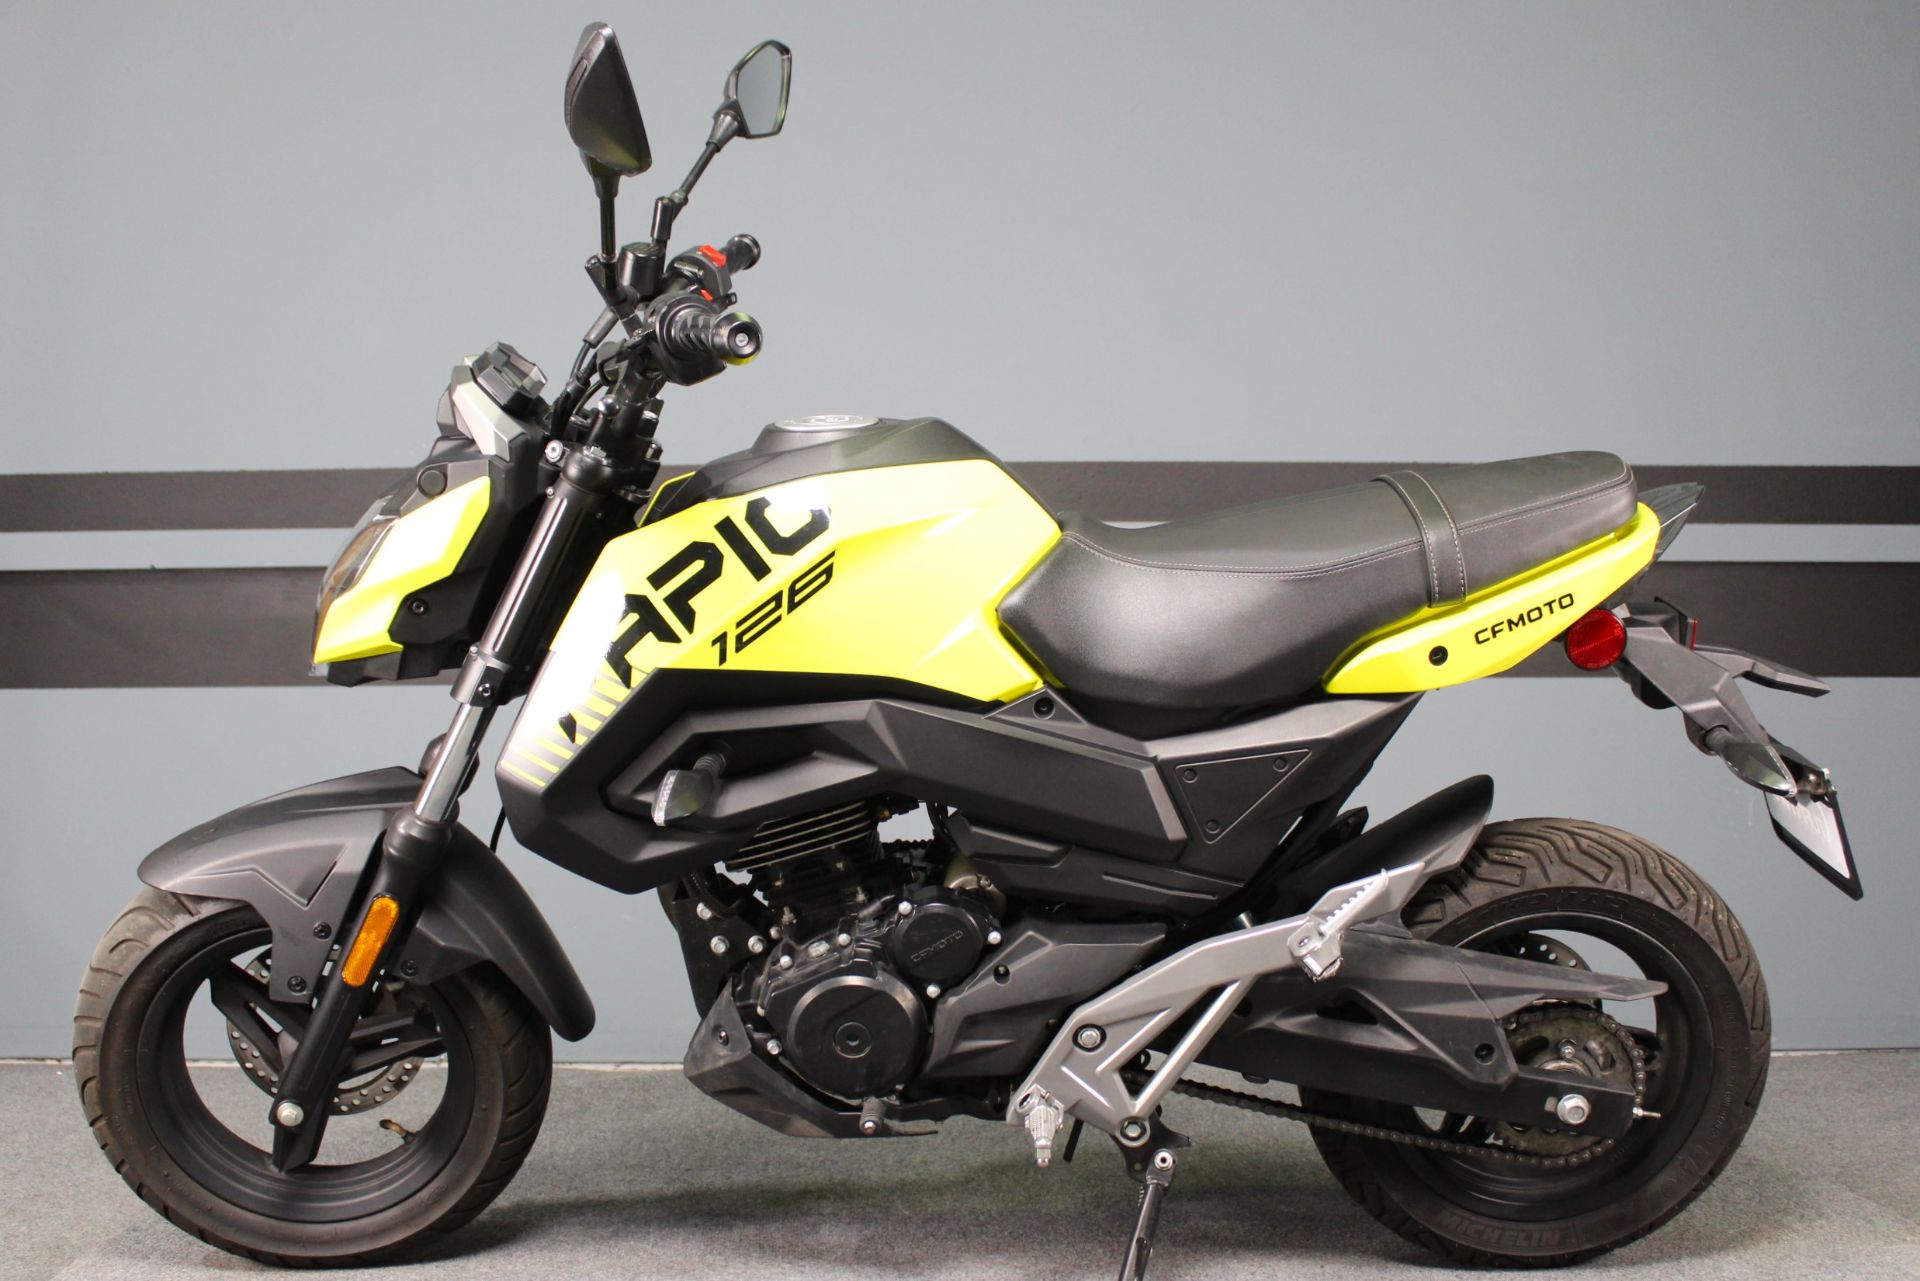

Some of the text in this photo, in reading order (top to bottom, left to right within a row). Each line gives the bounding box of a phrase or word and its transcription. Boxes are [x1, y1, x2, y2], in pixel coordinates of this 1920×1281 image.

[711, 549, 836, 667] 126
[1474, 592, 1575, 645] CFMOTO
[1436, 1209, 1562, 1247] MICHELIN
